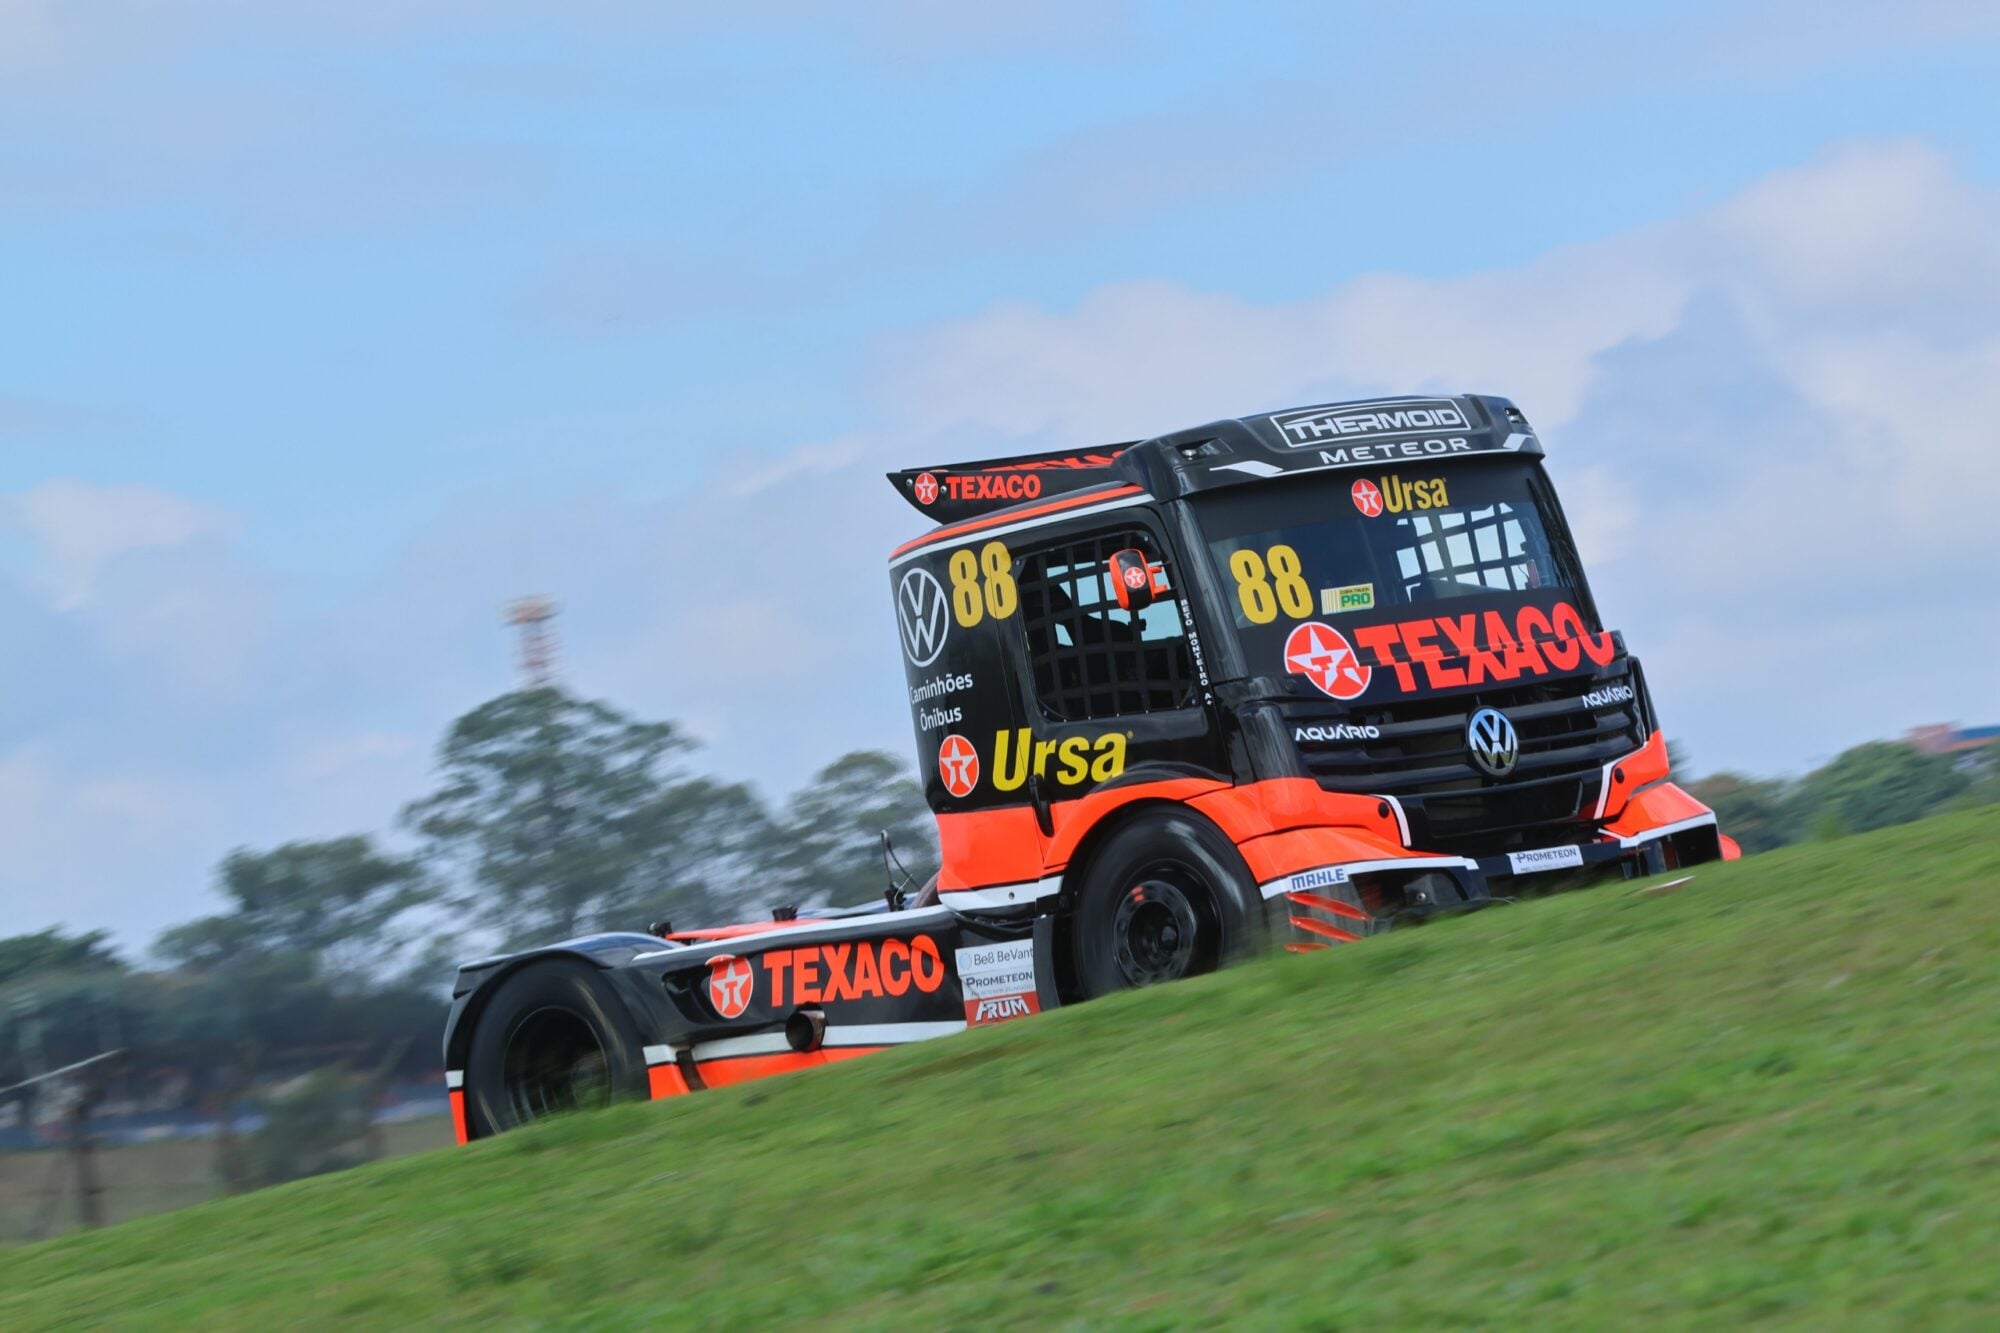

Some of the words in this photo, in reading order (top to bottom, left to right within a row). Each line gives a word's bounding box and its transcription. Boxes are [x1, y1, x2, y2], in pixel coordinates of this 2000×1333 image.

[1284, 409, 1462, 439] THERMOID
[1319, 437, 1471, 464] METEOR
[945, 475, 1041, 500] TEXACO
[1381, 474, 1449, 513] Ursa
[949, 541, 1017, 628] 88
[1229, 544, 1313, 624] 88
[1341, 592, 1371, 607] PRO
[1180, 598, 1193, 626] BETO
[1188, 631, 1209, 686] MONTEIRO
[1354, 602, 1615, 693] TEXACO
[909, 673, 974, 704] Caminhões
[1583, 685, 1633, 708] AQUÁRIO
[920, 706, 962, 731] Ônibus
[1295, 724, 1379, 741] AQUÁRIO
[1516, 848, 1577, 863] PROMETEON
[1291, 869, 1344, 890] MAHLE
[763, 934, 944, 1007] TEXACO
[974, 952, 995, 966] Be8
[965, 971, 1033, 988] PROMETEON
